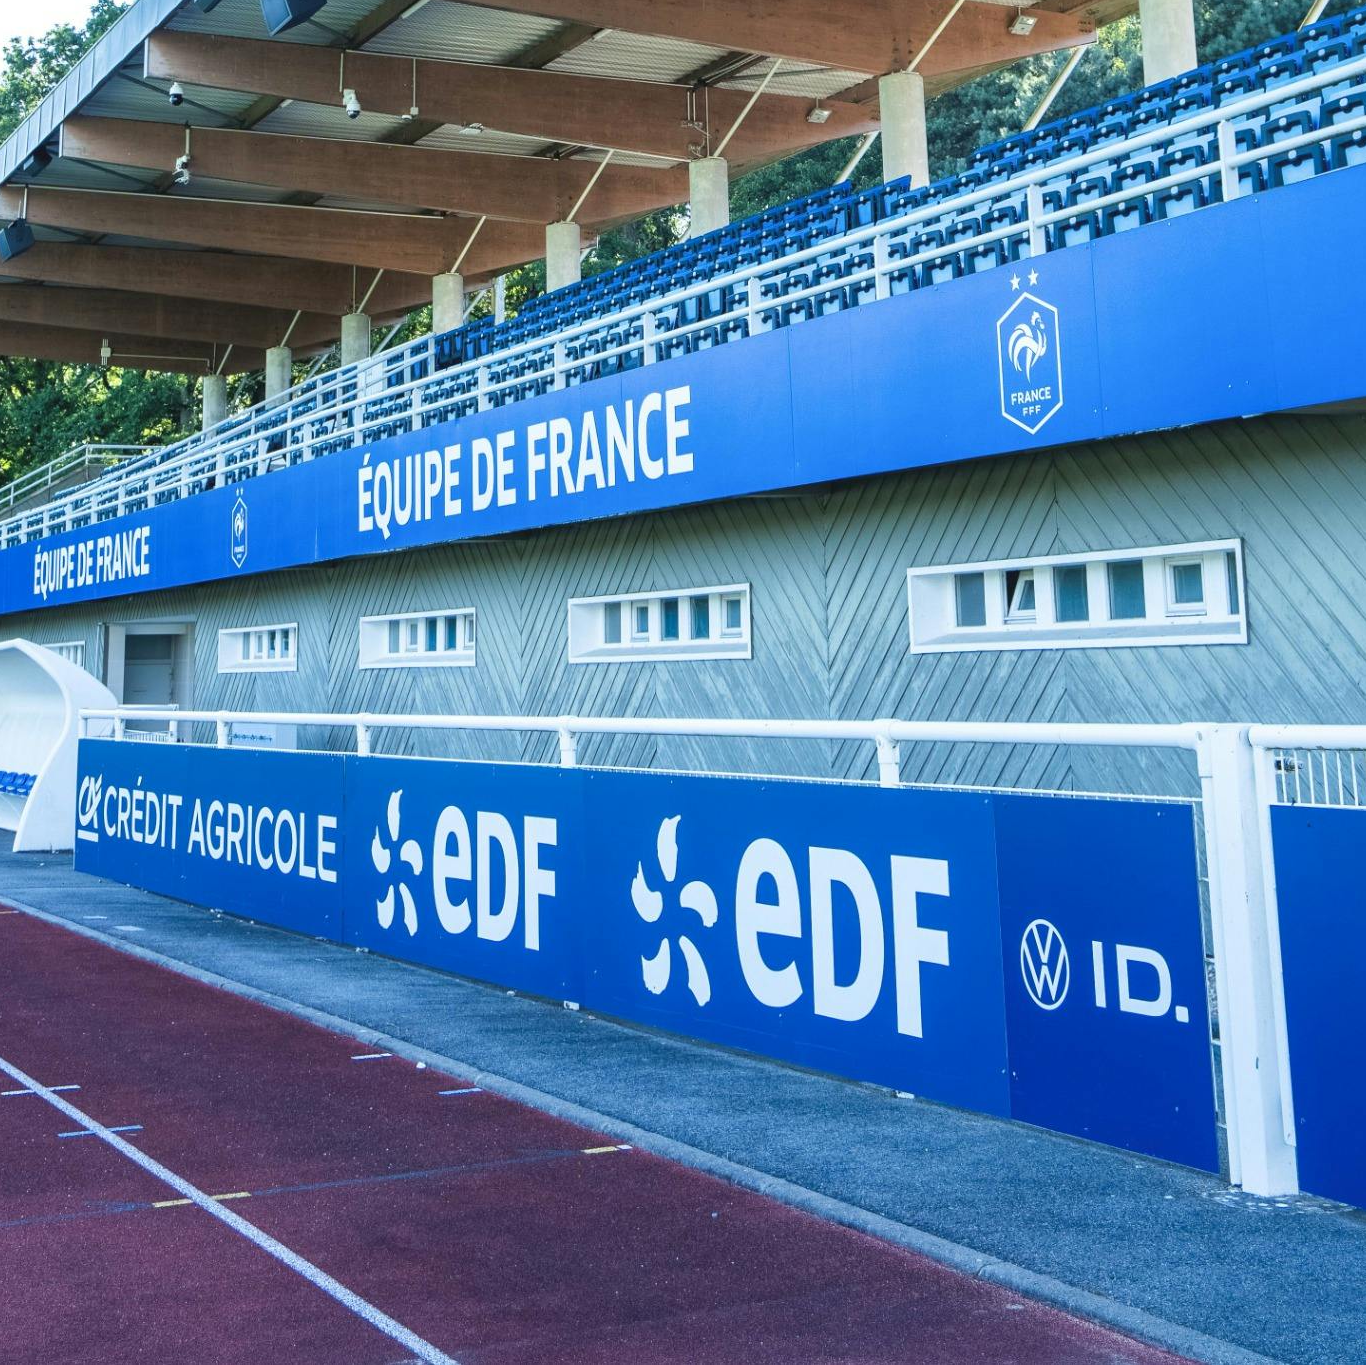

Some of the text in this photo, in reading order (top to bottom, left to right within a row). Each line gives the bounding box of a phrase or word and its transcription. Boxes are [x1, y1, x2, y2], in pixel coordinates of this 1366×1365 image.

[1011, 386, 1051, 405] FRANCE
[1022, 405, 1041, 416] FFF
[358, 385, 694, 540] ÉQUIPE DE FRANCE
[34, 526, 150, 600] ÉQUIPE DE FRANCE
[103, 776, 182, 850] CRÉDIT
[187, 798, 337, 883] AGRICOLE
[1092, 941, 1189, 1023] ID.
